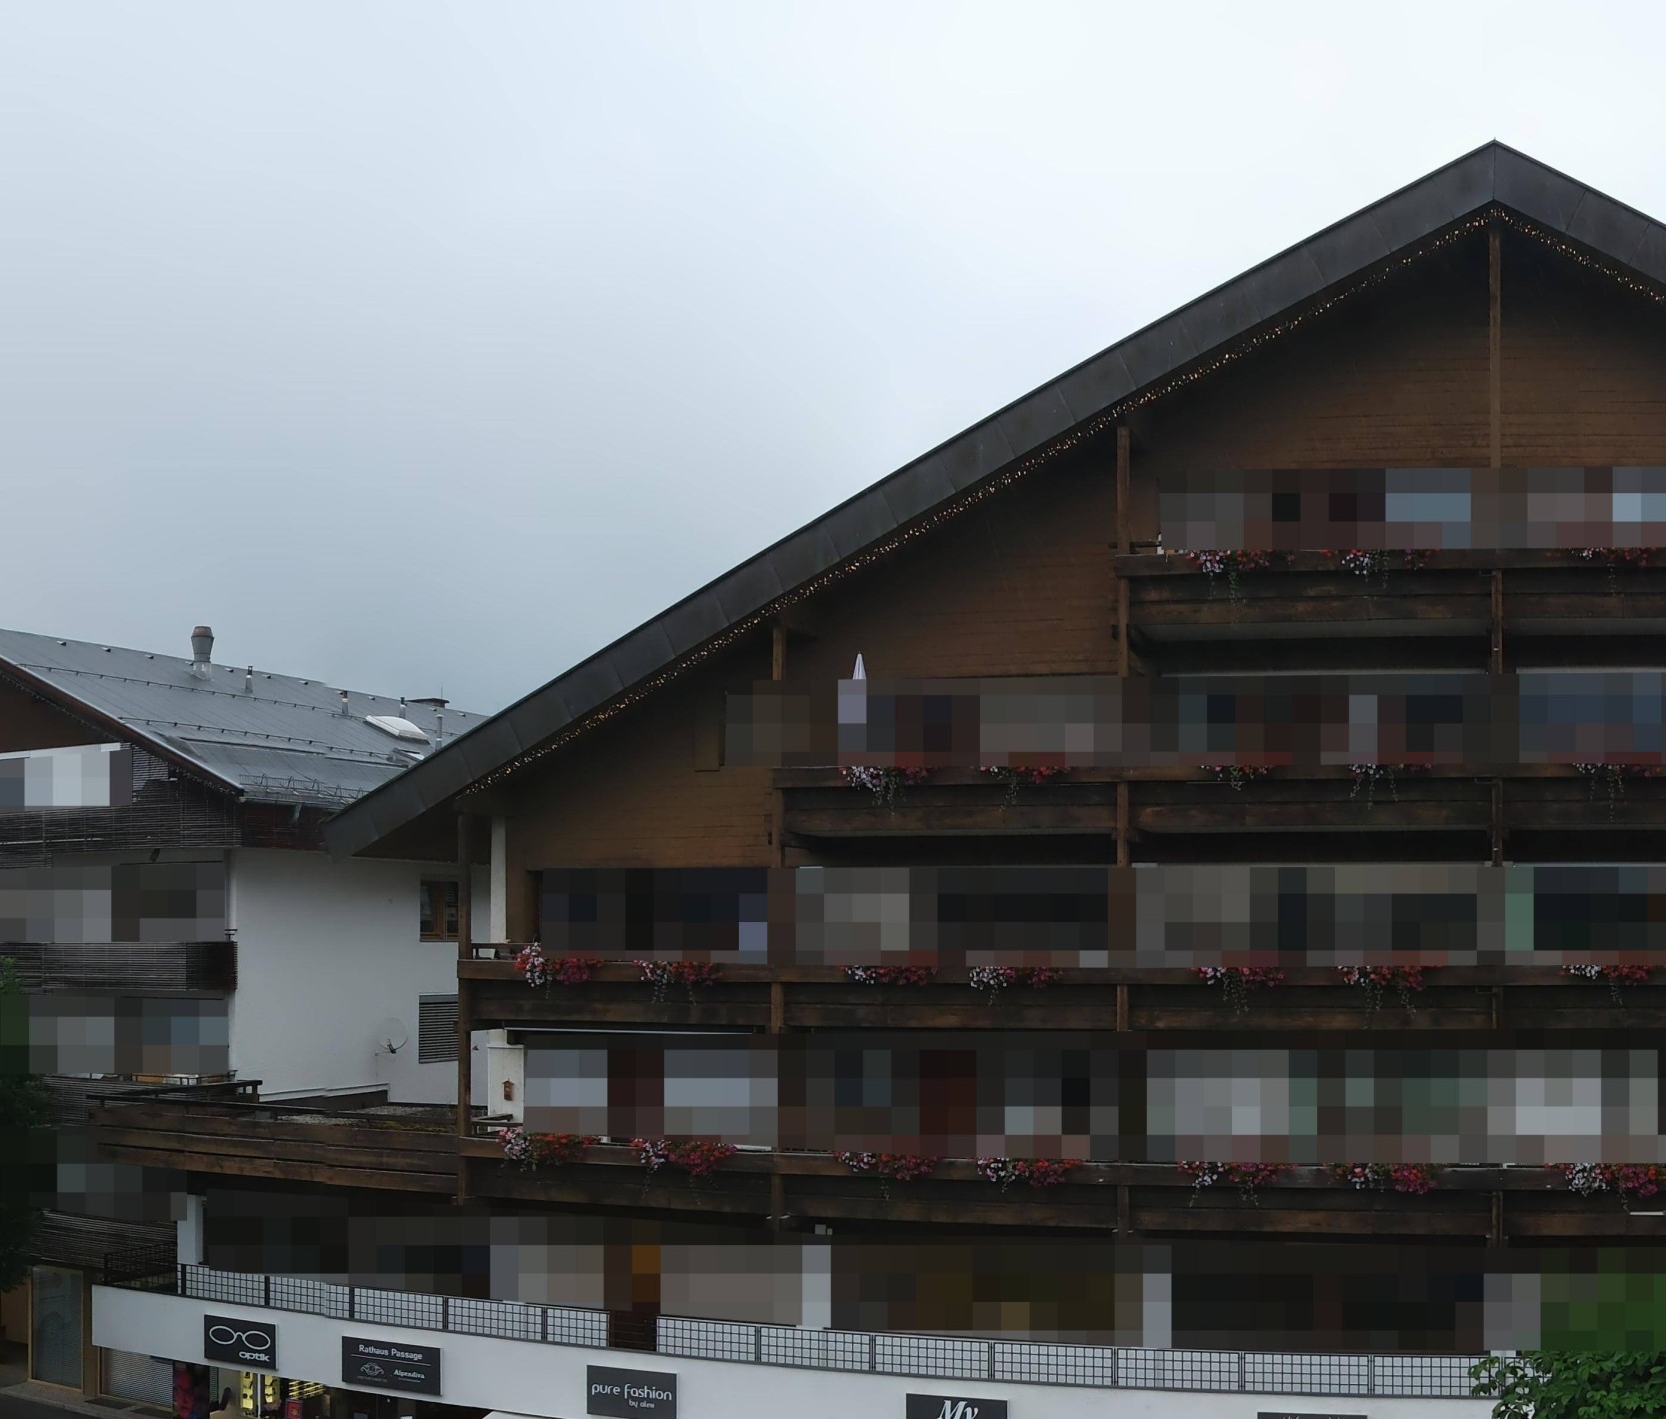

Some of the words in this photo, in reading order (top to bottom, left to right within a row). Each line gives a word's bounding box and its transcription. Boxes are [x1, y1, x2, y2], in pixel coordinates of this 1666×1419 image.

[238, 1350, 270, 1363] optik
[359, 1344, 389, 1356] Rathaus
[391, 1348, 423, 1361] Passage
[591, 1382, 620, 1397] pure
[624, 1383, 672, 1401] fashion
